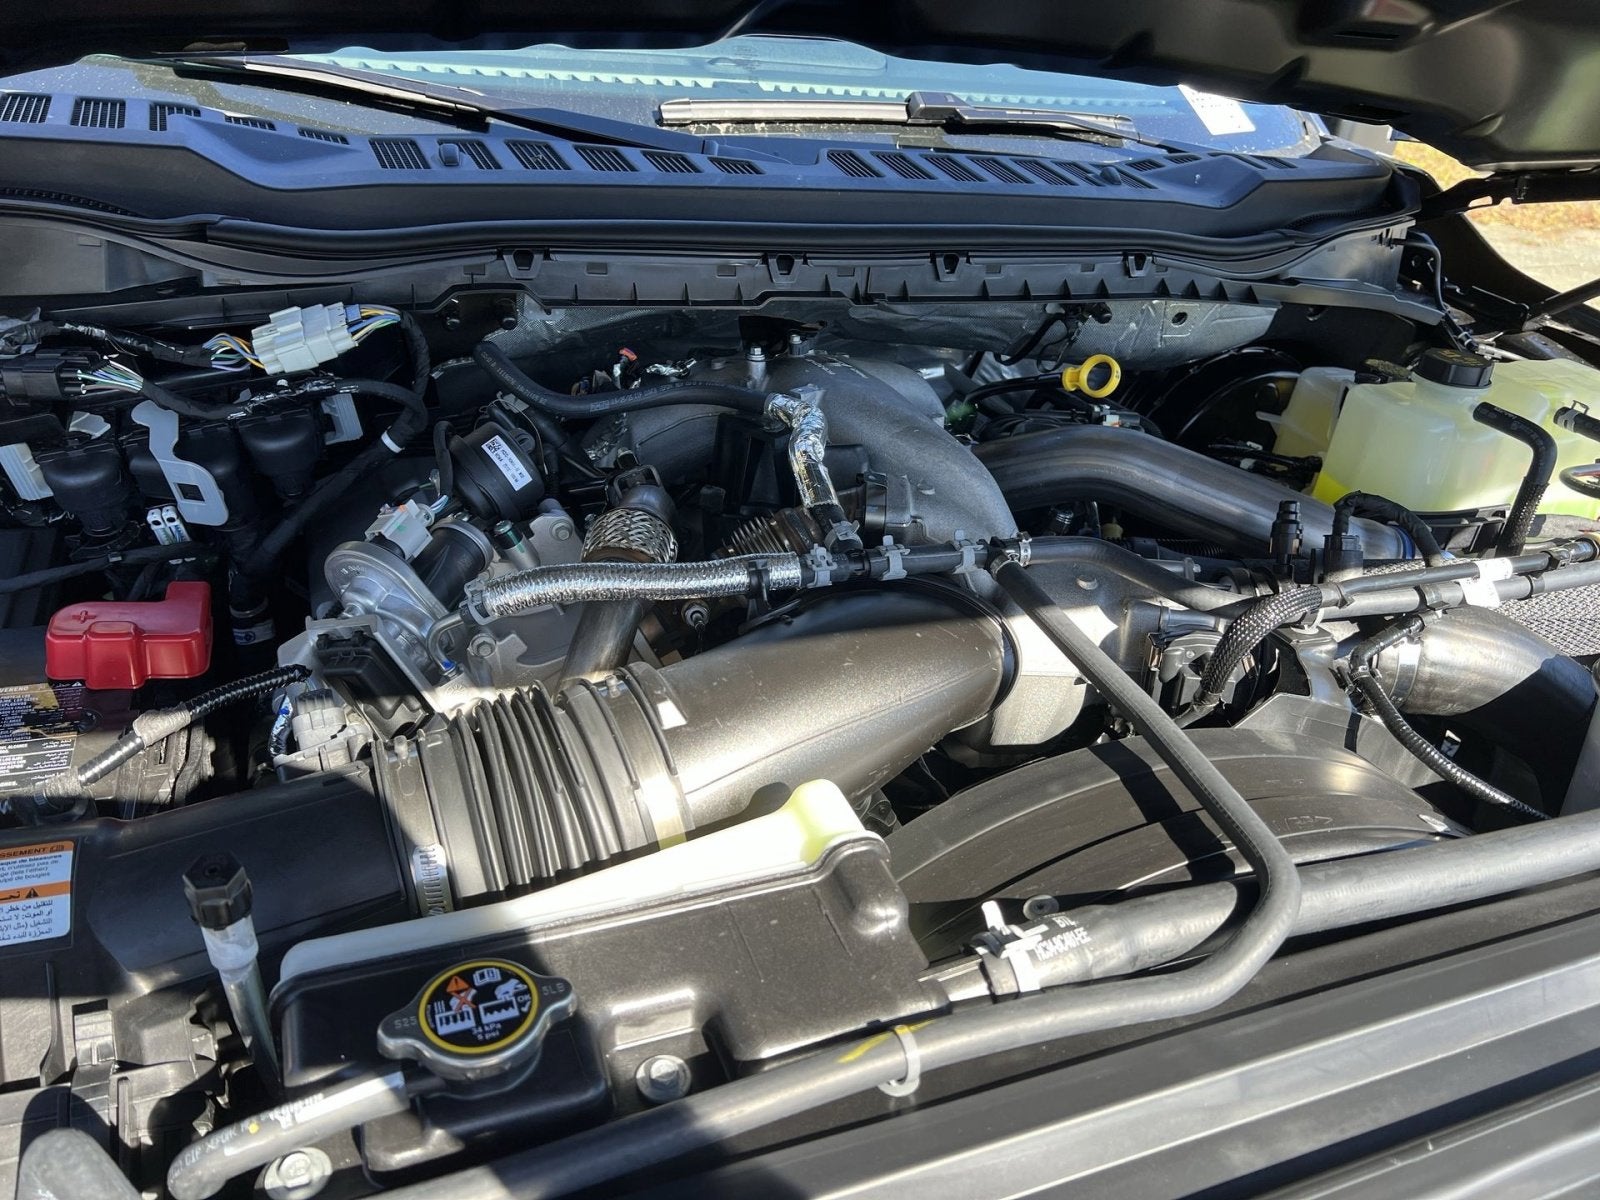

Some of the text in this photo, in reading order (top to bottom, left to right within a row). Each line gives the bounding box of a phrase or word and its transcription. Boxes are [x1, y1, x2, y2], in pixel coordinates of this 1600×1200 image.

[517, 994, 531, 1003] OK
[484, 1022, 502, 1031] kPa
[485, 1031, 499, 1040] psi
